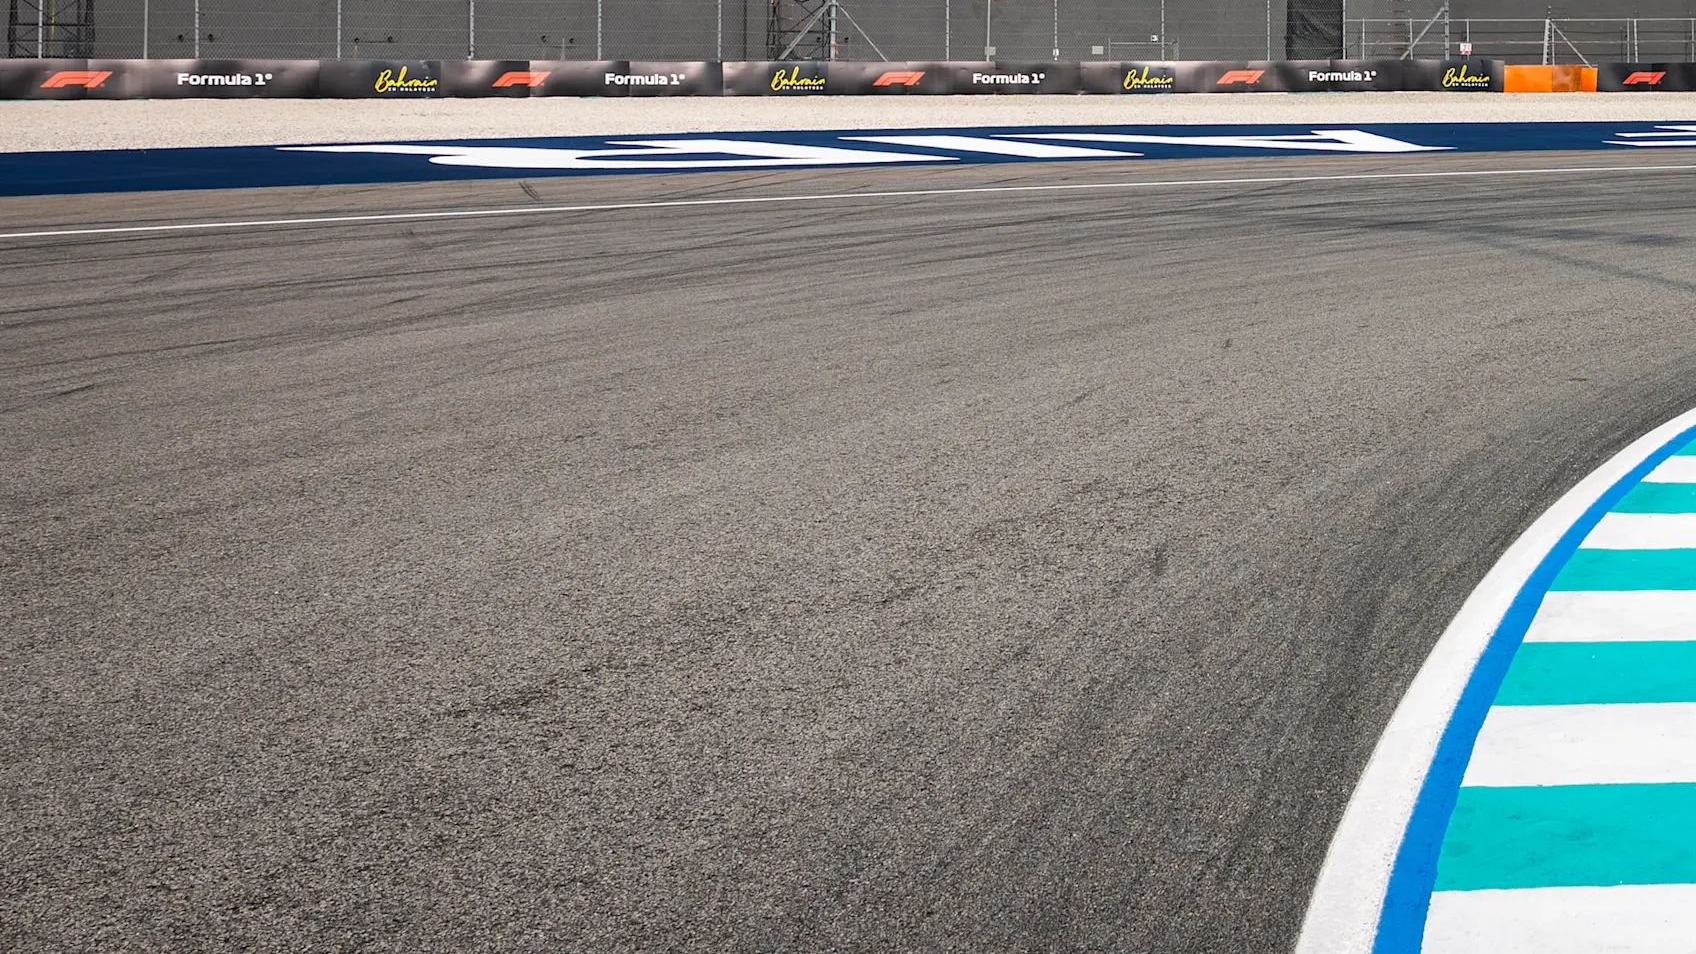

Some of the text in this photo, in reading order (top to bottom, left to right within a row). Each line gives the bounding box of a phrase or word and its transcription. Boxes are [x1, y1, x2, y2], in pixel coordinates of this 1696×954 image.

[40, 71, 112, 88] F1
[177, 72, 251, 85] Formula
[375, 66, 437, 92] Bahrain
[492, 72, 551, 87] F1
[605, 72, 669, 85] Formula
[771, 66, 825, 91] Bahrain
[873, 71, 925, 86] F1
[972, 72, 1029, 84] Formula
[1123, 66, 1173, 90] Bahrain
[1217, 70, 1265, 85] F1
[1309, 70, 1362, 81] Formula
[1441, 65, 1491, 88] Bahrain
[1623, 72, 1666, 85] F1
[278, 129, 1452, 169] AIR
